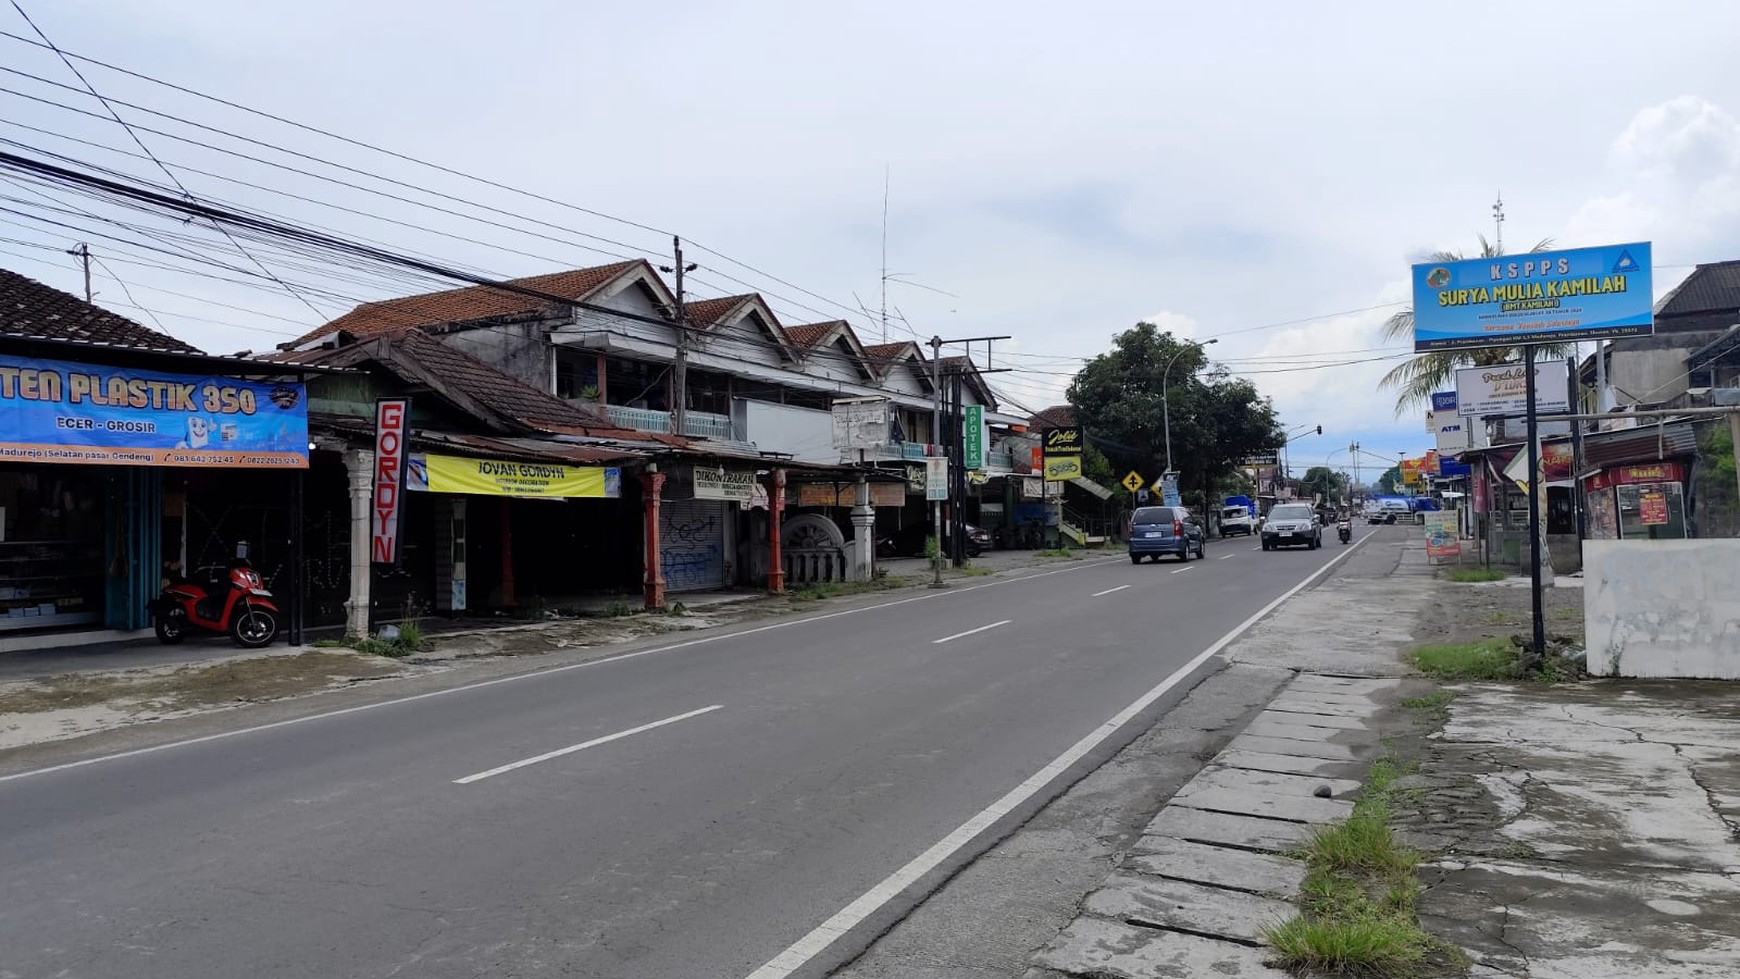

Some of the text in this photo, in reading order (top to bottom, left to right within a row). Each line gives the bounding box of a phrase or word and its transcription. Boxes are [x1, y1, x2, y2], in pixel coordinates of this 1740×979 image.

[1438, 274, 1627, 307] SURYA MULIA KAMILAH
[69, 371, 198, 411] PLASTIK
[202, 383, 257, 415] 350
[56, 417, 94, 430] ECER
[106, 420, 156, 433] GROSIR
[968, 407, 978, 460] APOTEK
[44, 449, 83, 460] (Selatan
[478, 461, 565, 479] JOVAN GORDYN
[373, 404, 401, 564] GORDYN
